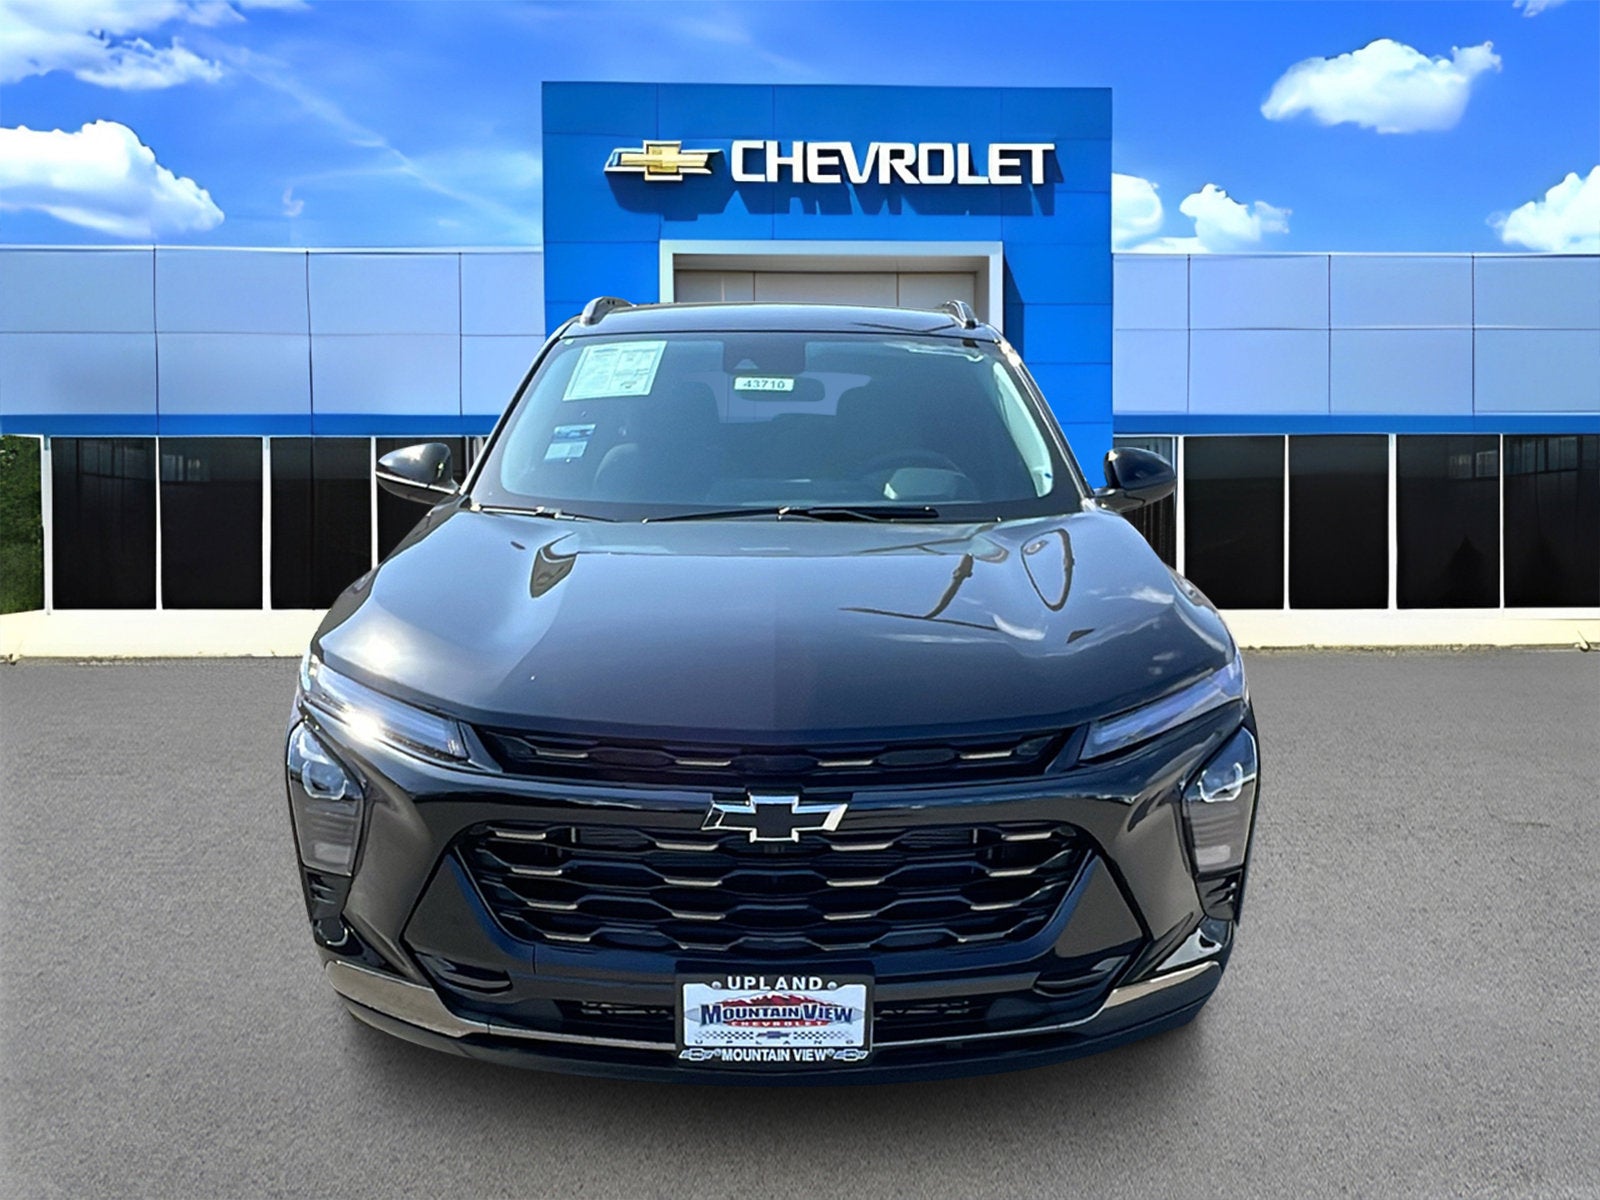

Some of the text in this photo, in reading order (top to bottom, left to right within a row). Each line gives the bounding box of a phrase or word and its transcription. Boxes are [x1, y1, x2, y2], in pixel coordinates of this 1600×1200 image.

[731, 140, 1055, 184] CHEVROLET
[743, 379, 786, 389] 43710
[727, 976, 823, 990] UPLAND
[721, 1049, 827, 1061] MOUNTAIN VIEW
